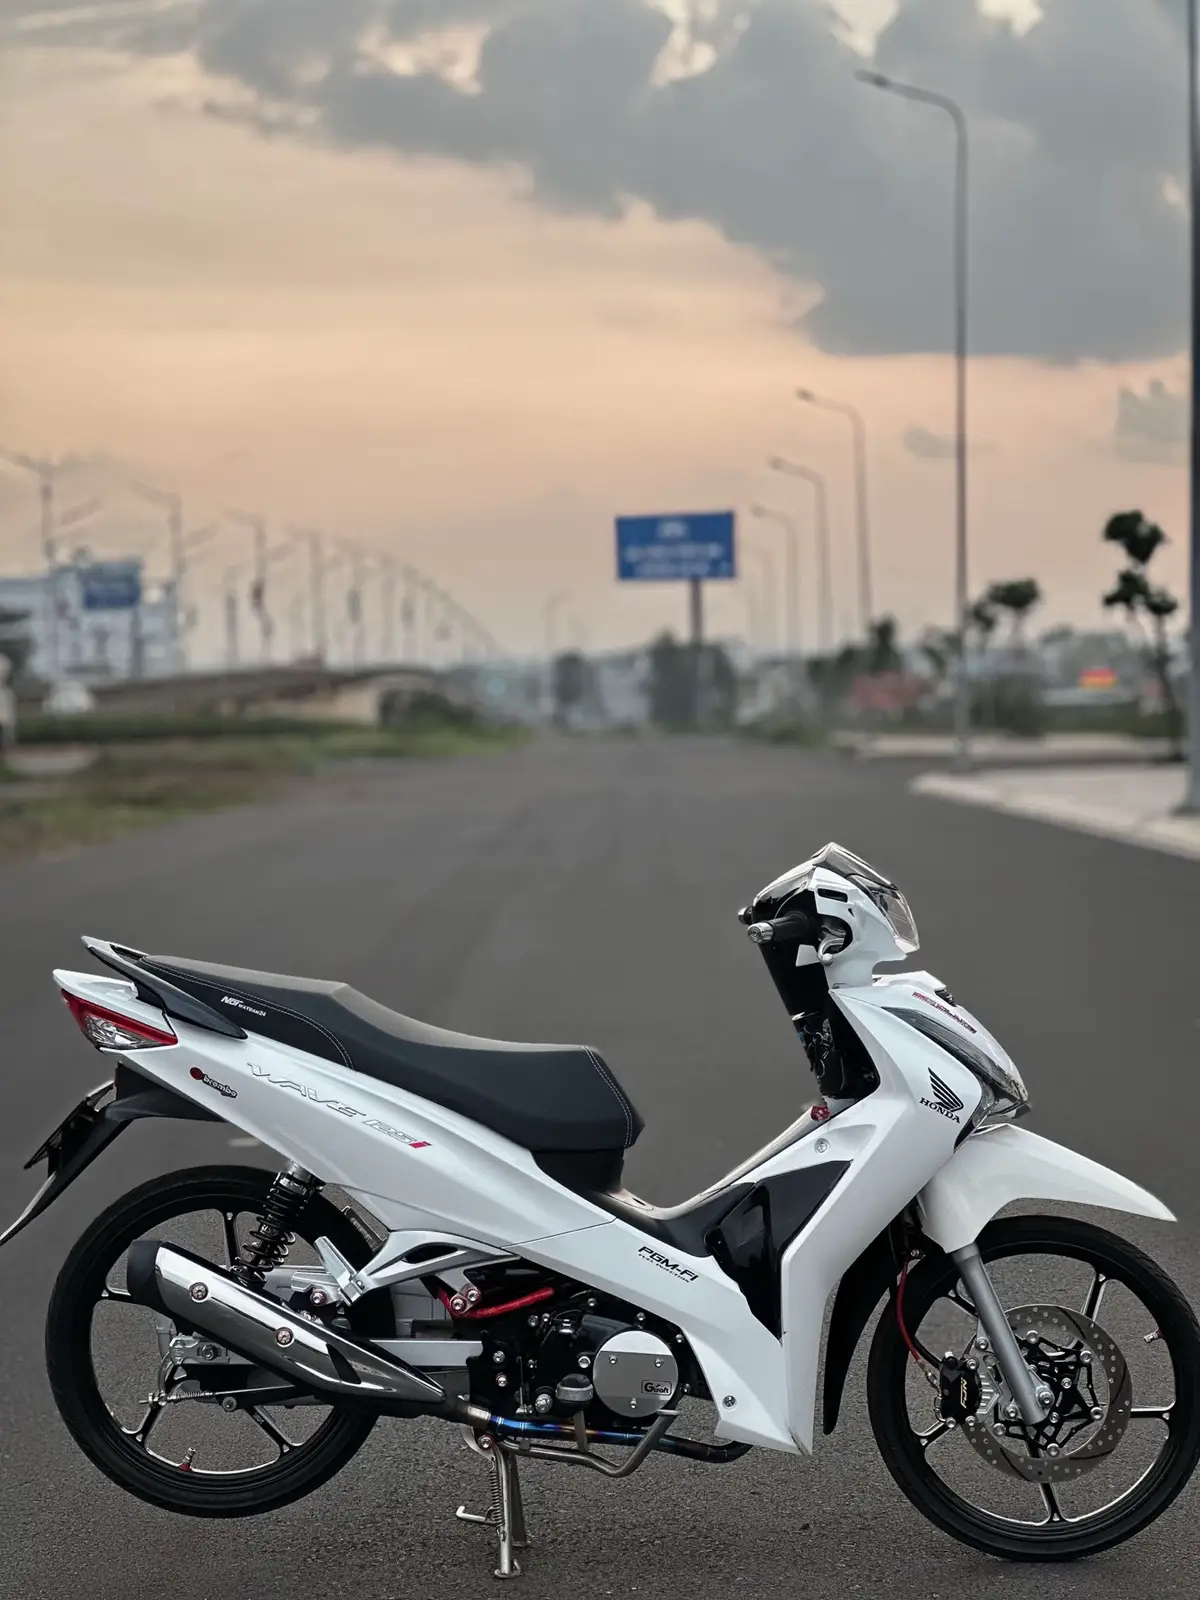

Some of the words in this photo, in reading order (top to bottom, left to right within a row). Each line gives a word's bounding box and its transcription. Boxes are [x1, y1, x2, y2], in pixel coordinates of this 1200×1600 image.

[247, 1062, 367, 1118] WAVE
[919, 1097, 961, 1124] HONDA
[638, 1245, 699, 1282] PGM-FI
